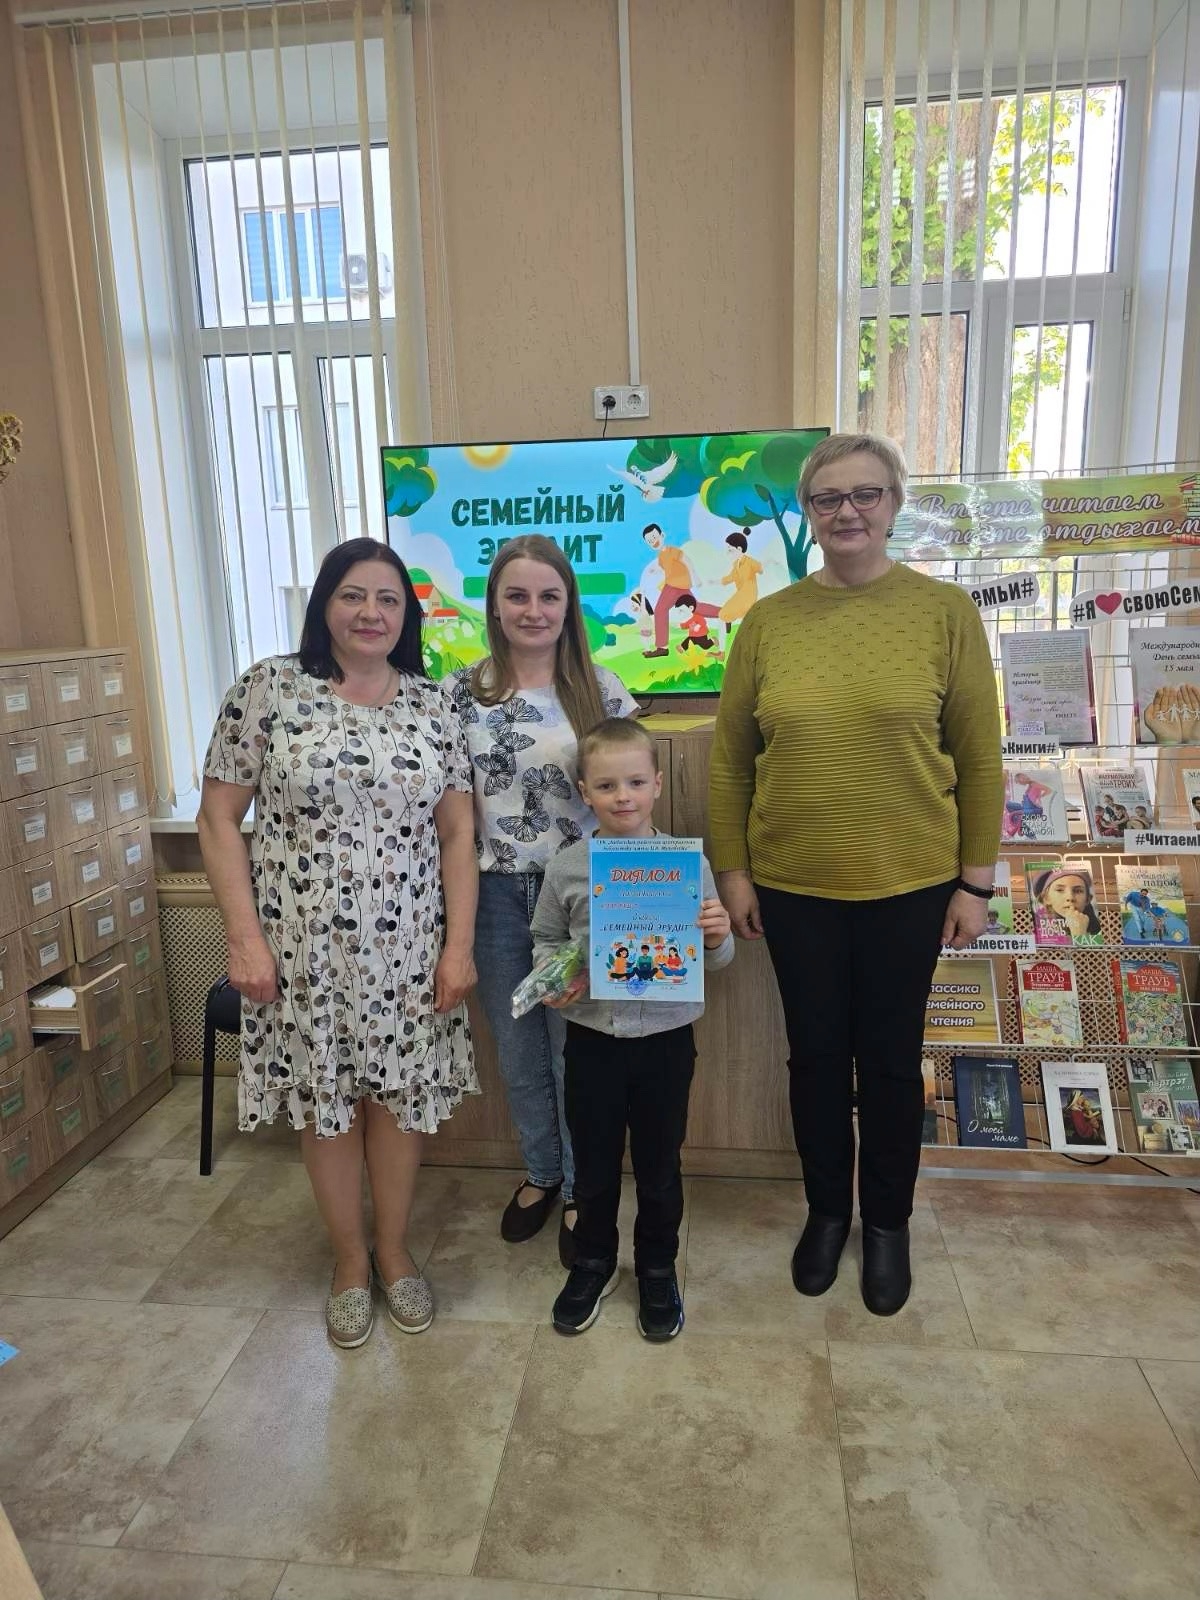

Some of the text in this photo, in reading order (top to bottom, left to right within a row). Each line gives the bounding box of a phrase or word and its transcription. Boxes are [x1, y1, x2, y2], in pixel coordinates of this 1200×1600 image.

[451, 486, 626, 527] СЕМЕЙНЫЙ
[918, 493, 1165, 520] Вмсте читаем
[922, 518, 1200, 545] вмете отдыхаем
[477, 534, 603, 566] ЭИТ
[1136, 833, 1200, 847] #Читаем
[1028, 972, 1065, 983] ТРАУБ
[1133, 975, 1170, 987] ТРАУБ
[930, 1017, 975, 1027] чтения
[967, 1119, 979, 1133] О
